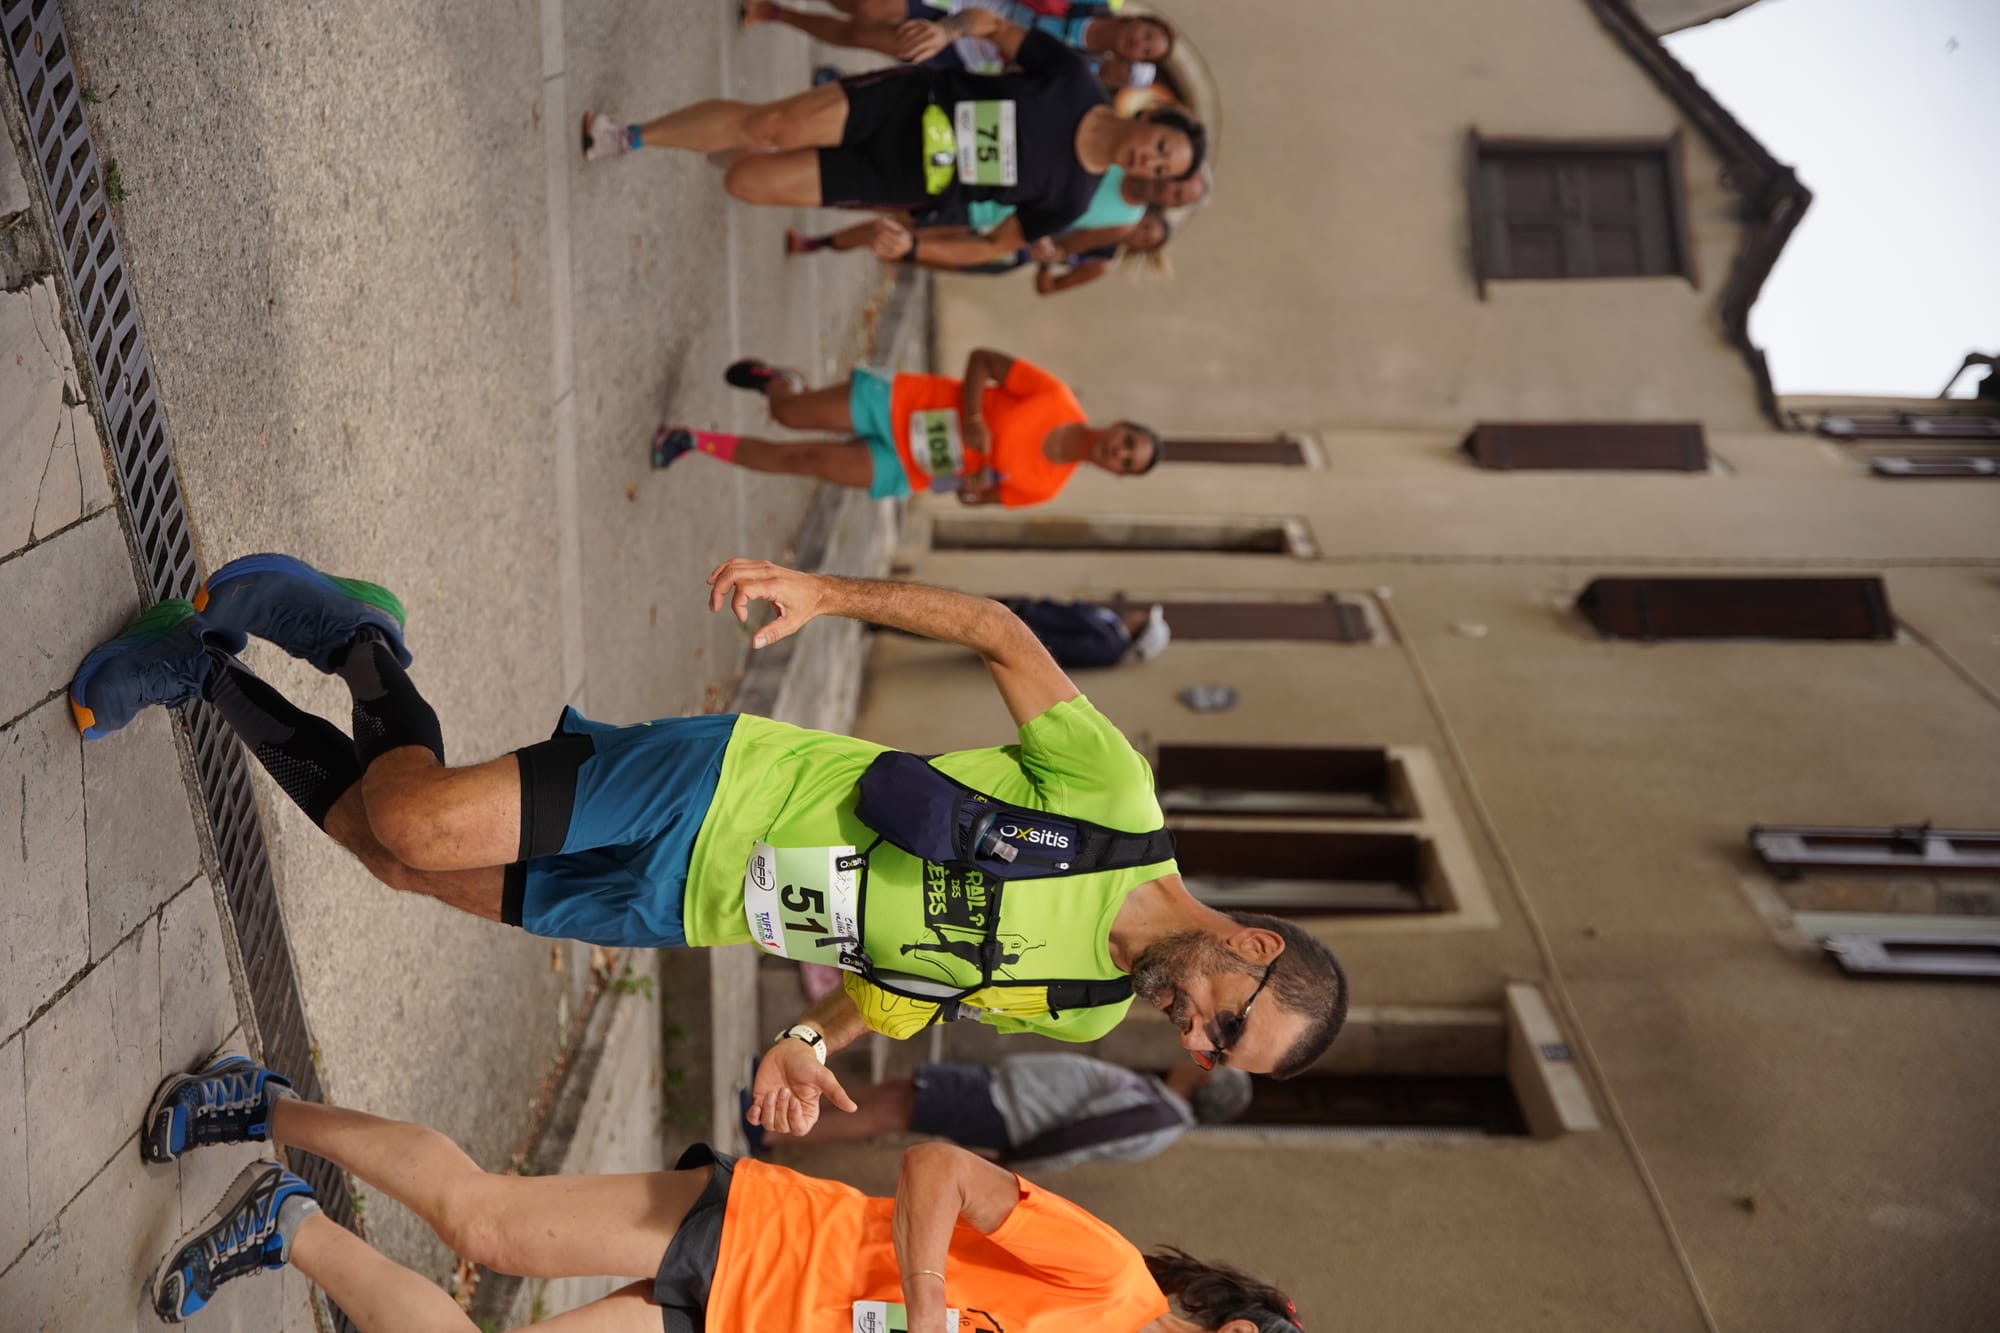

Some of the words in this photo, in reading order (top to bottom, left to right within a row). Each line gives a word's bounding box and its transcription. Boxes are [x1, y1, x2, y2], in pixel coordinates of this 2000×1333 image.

[977, 124, 999, 162] 75
[1000, 825, 1069, 849] Oxsitis
[757, 855, 766, 886] BFP
[927, 860, 951, 916] ÈPES
[951, 879, 962, 899] DES
[965, 871, 987, 911] RAIL
[760, 912, 774, 939] TUFF'S
[780, 884, 829, 934] 51
